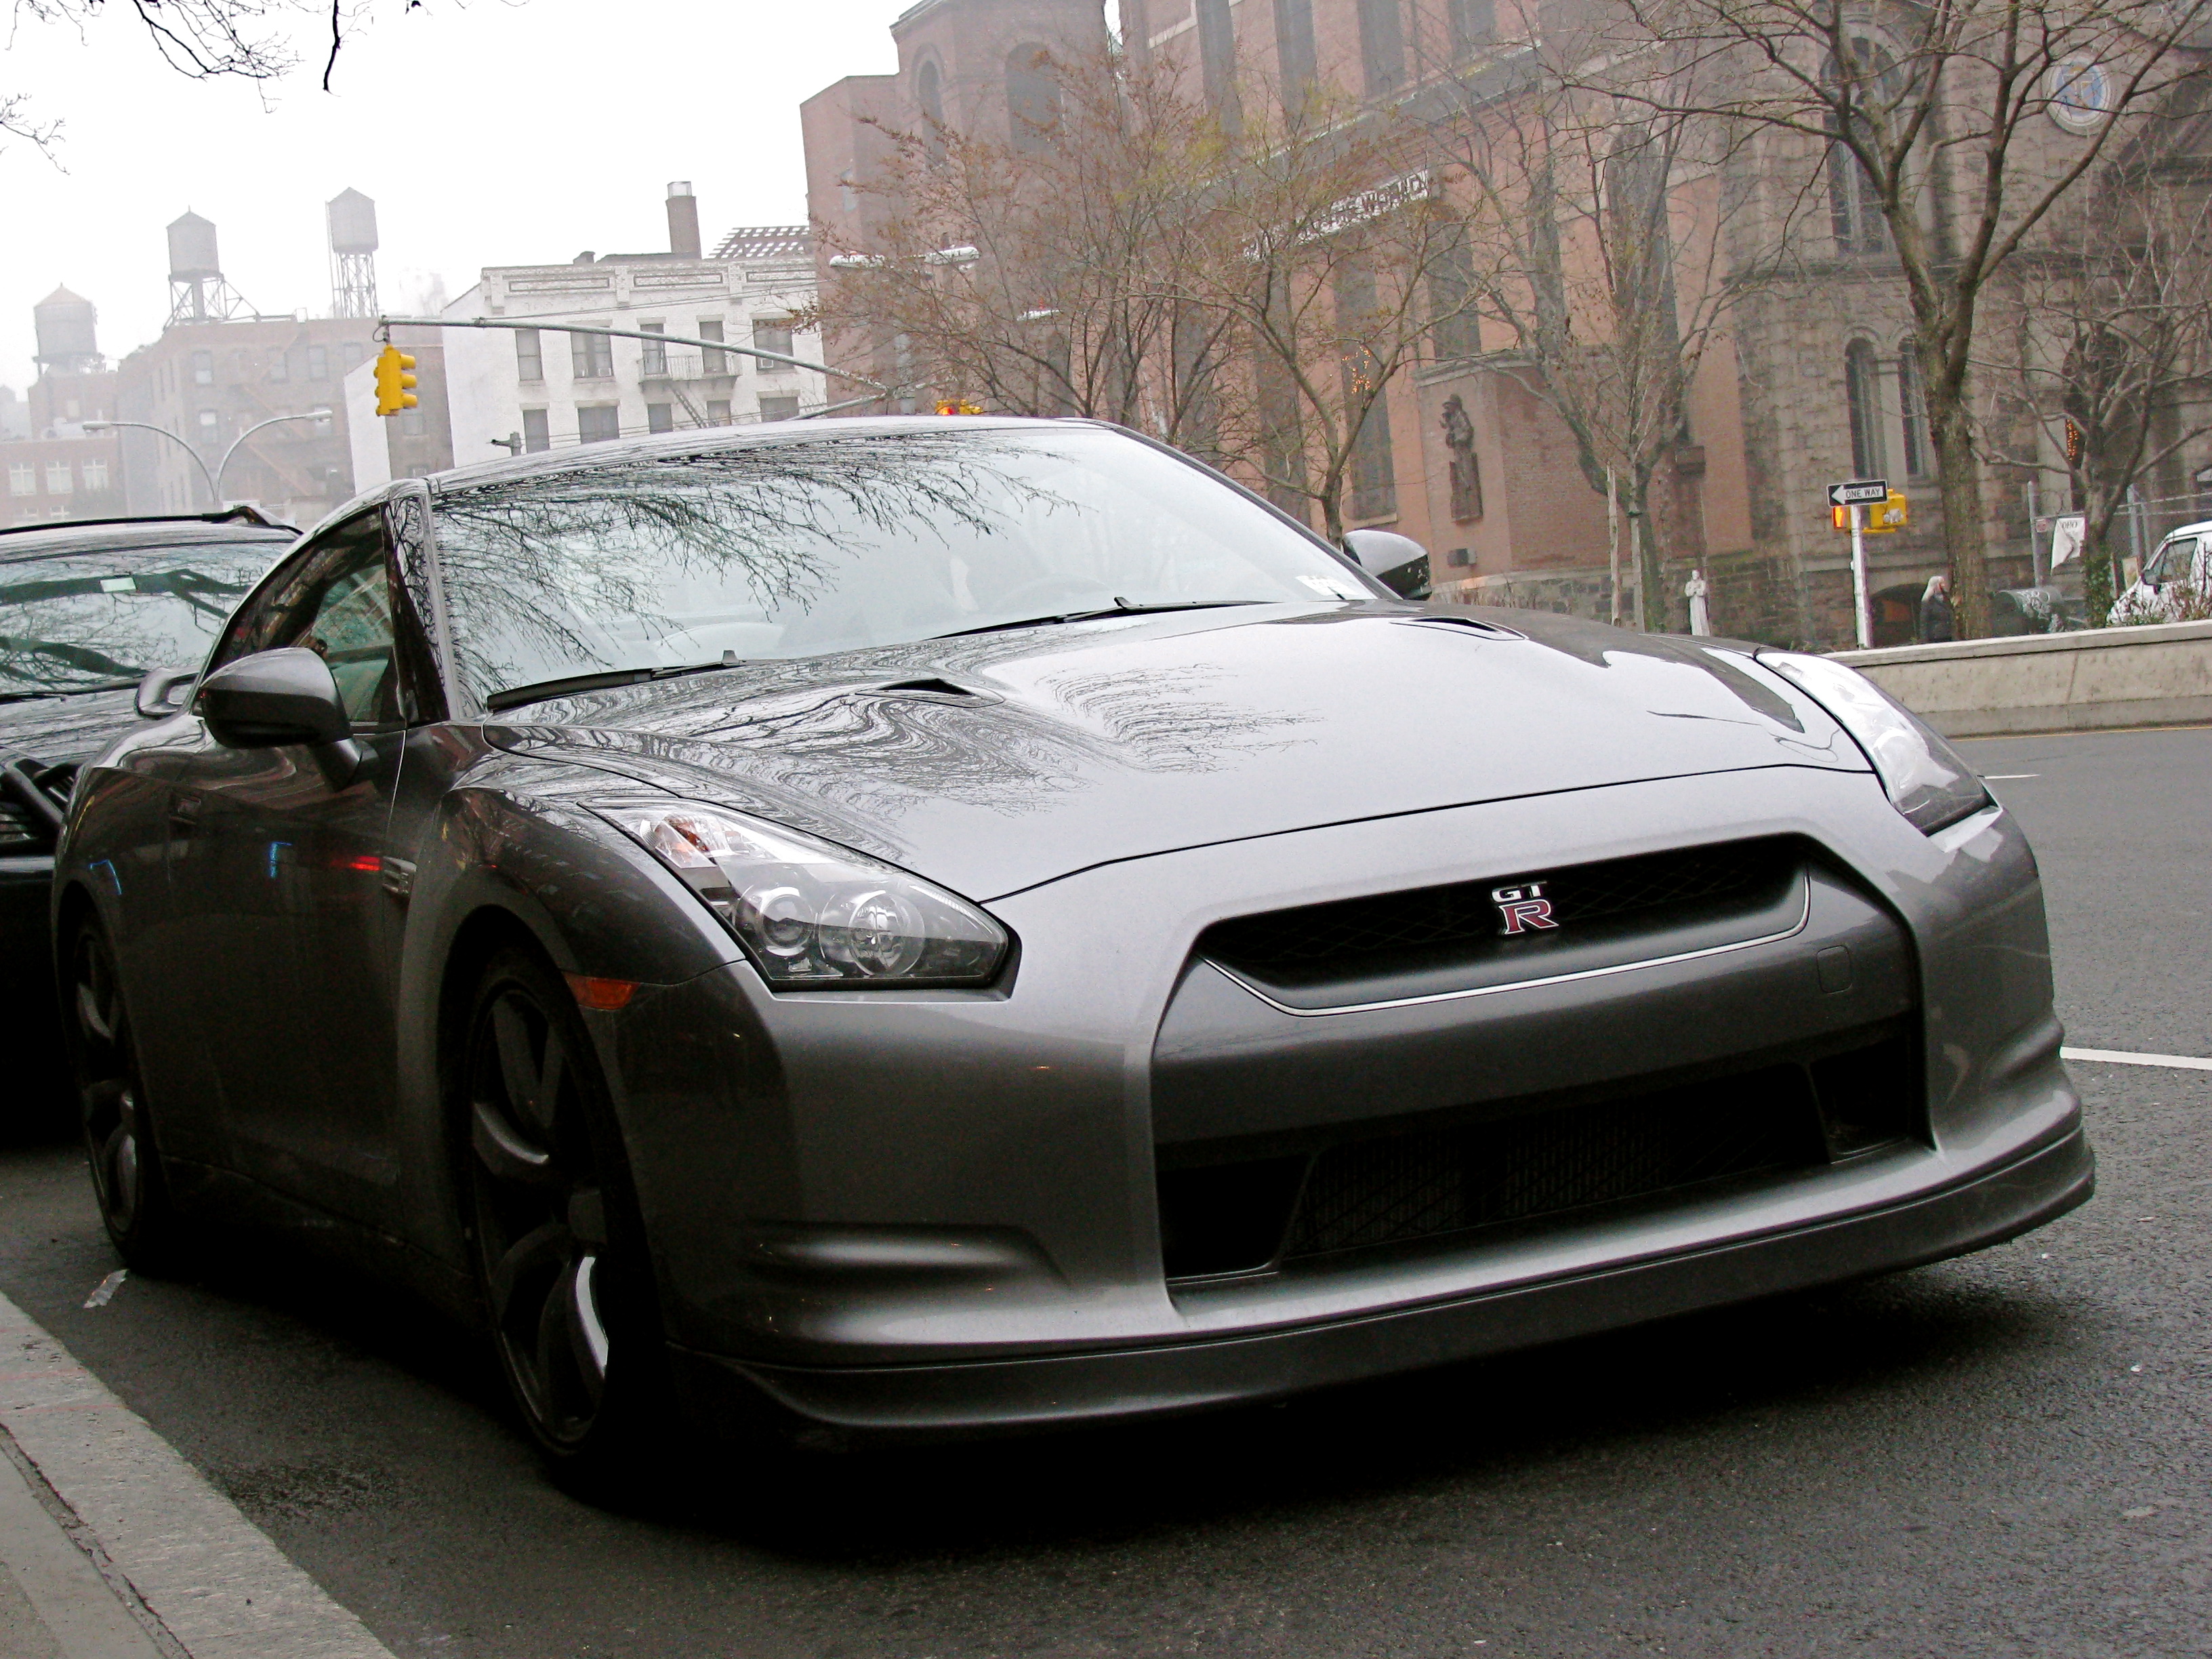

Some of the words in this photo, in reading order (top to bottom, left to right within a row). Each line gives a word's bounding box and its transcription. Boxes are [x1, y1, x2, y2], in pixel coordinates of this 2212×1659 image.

[1845, 489, 1862, 499] ONE
[1864, 487, 1881, 497] WAY
[1492, 881, 1547, 903] GT
[1498, 899, 1559, 935] R
